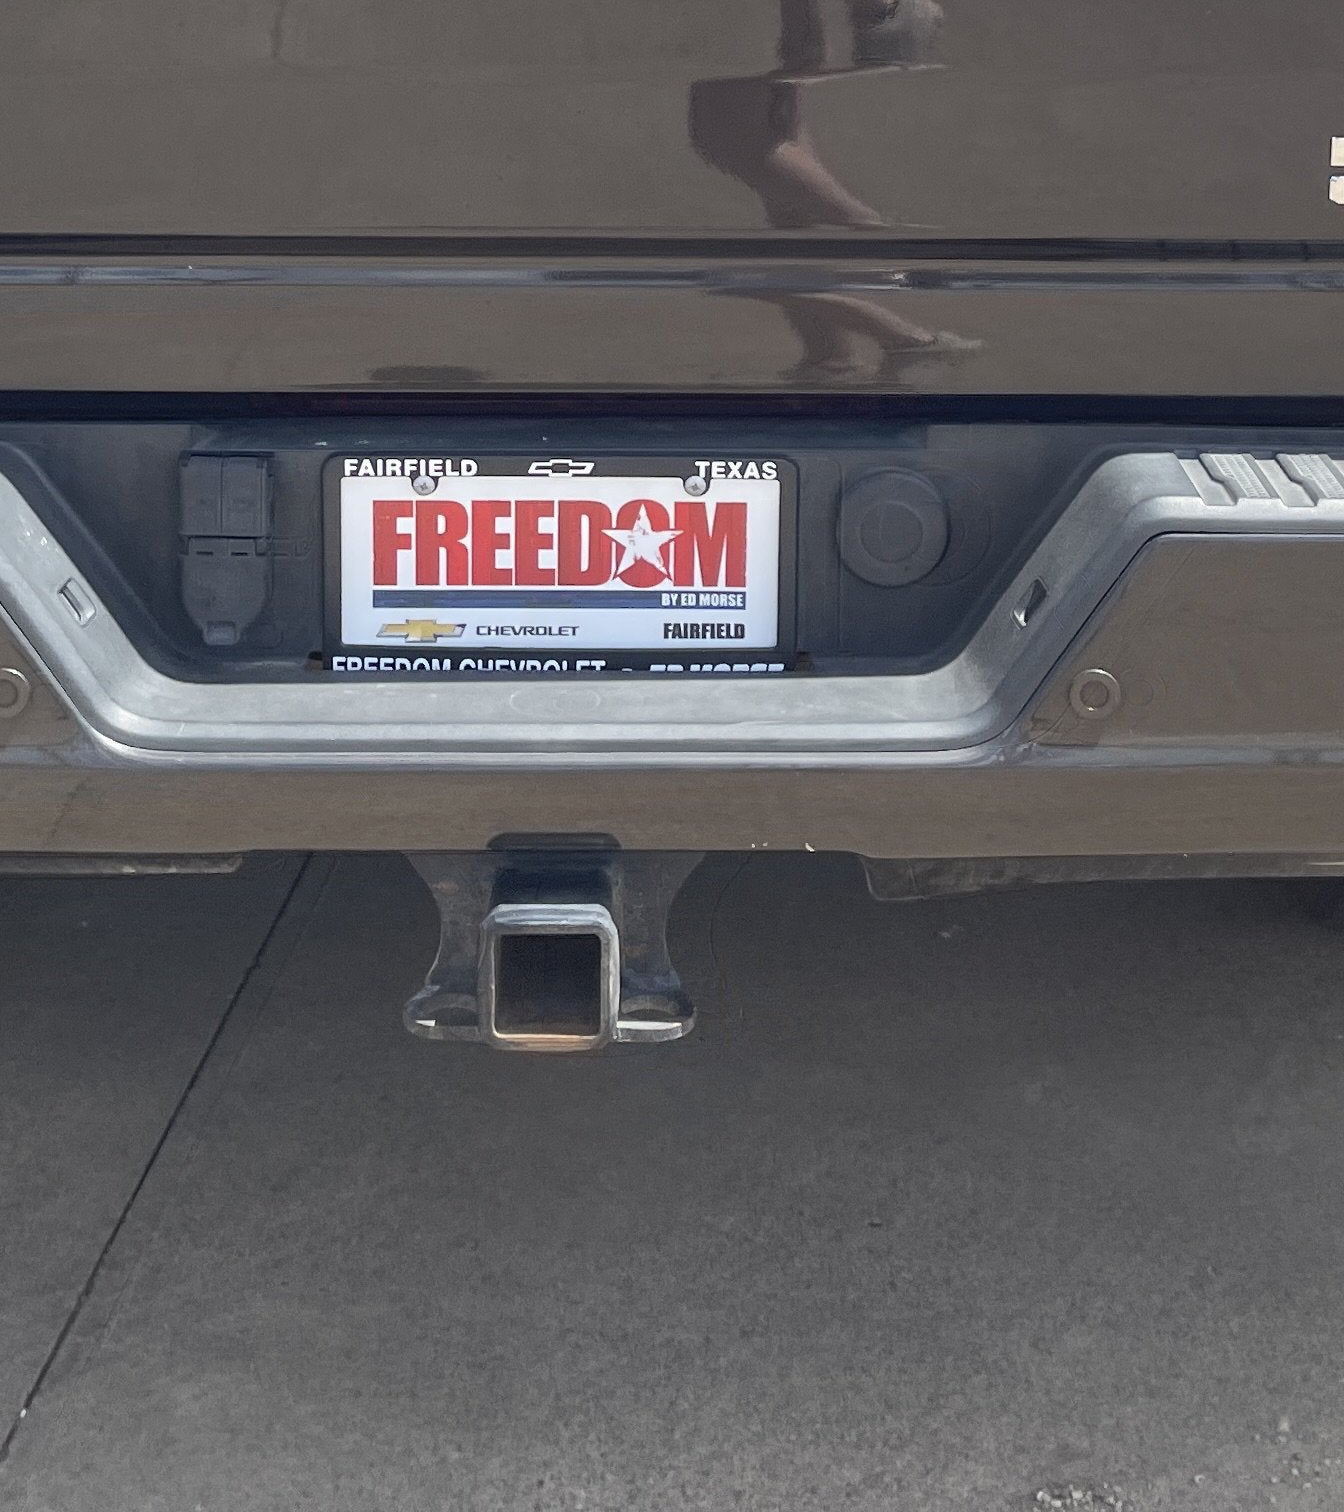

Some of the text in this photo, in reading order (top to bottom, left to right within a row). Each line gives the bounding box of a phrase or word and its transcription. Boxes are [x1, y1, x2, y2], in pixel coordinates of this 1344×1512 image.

[344, 459, 778, 480] FAIRFIELD TEXAS
[372, 498, 747, 588] FREEDOM
[661, 592, 744, 607] BY ED MORSE
[476, 625, 580, 637] CHEVROLET
[663, 622, 746, 640] FAIRFIELD
